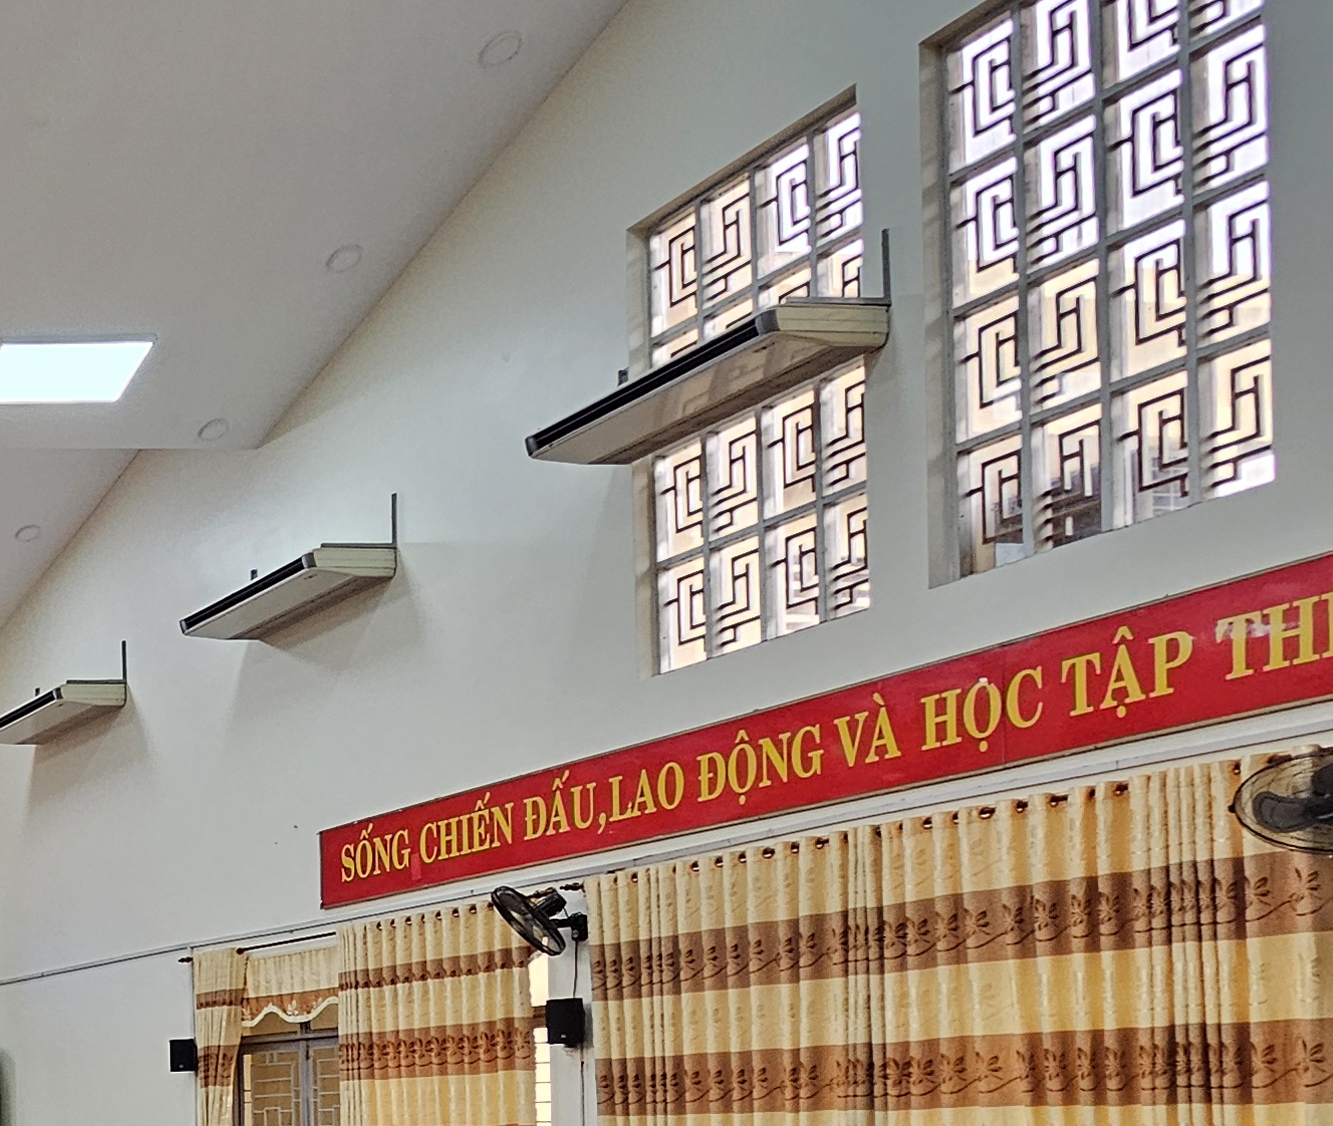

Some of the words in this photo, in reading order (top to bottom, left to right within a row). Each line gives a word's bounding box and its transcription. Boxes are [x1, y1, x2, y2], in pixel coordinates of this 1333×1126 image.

[340, 822, 412, 884] SỐNG
[418, 792, 514, 864] CHIẾN
[697, 723, 824, 805] ĐỘNG
[834, 691, 901, 768] VÀ
[920, 666, 1043, 752] HỌC
[1061, 626, 1196, 718] TẬP
[1215, 592, 1333, 681] TH
